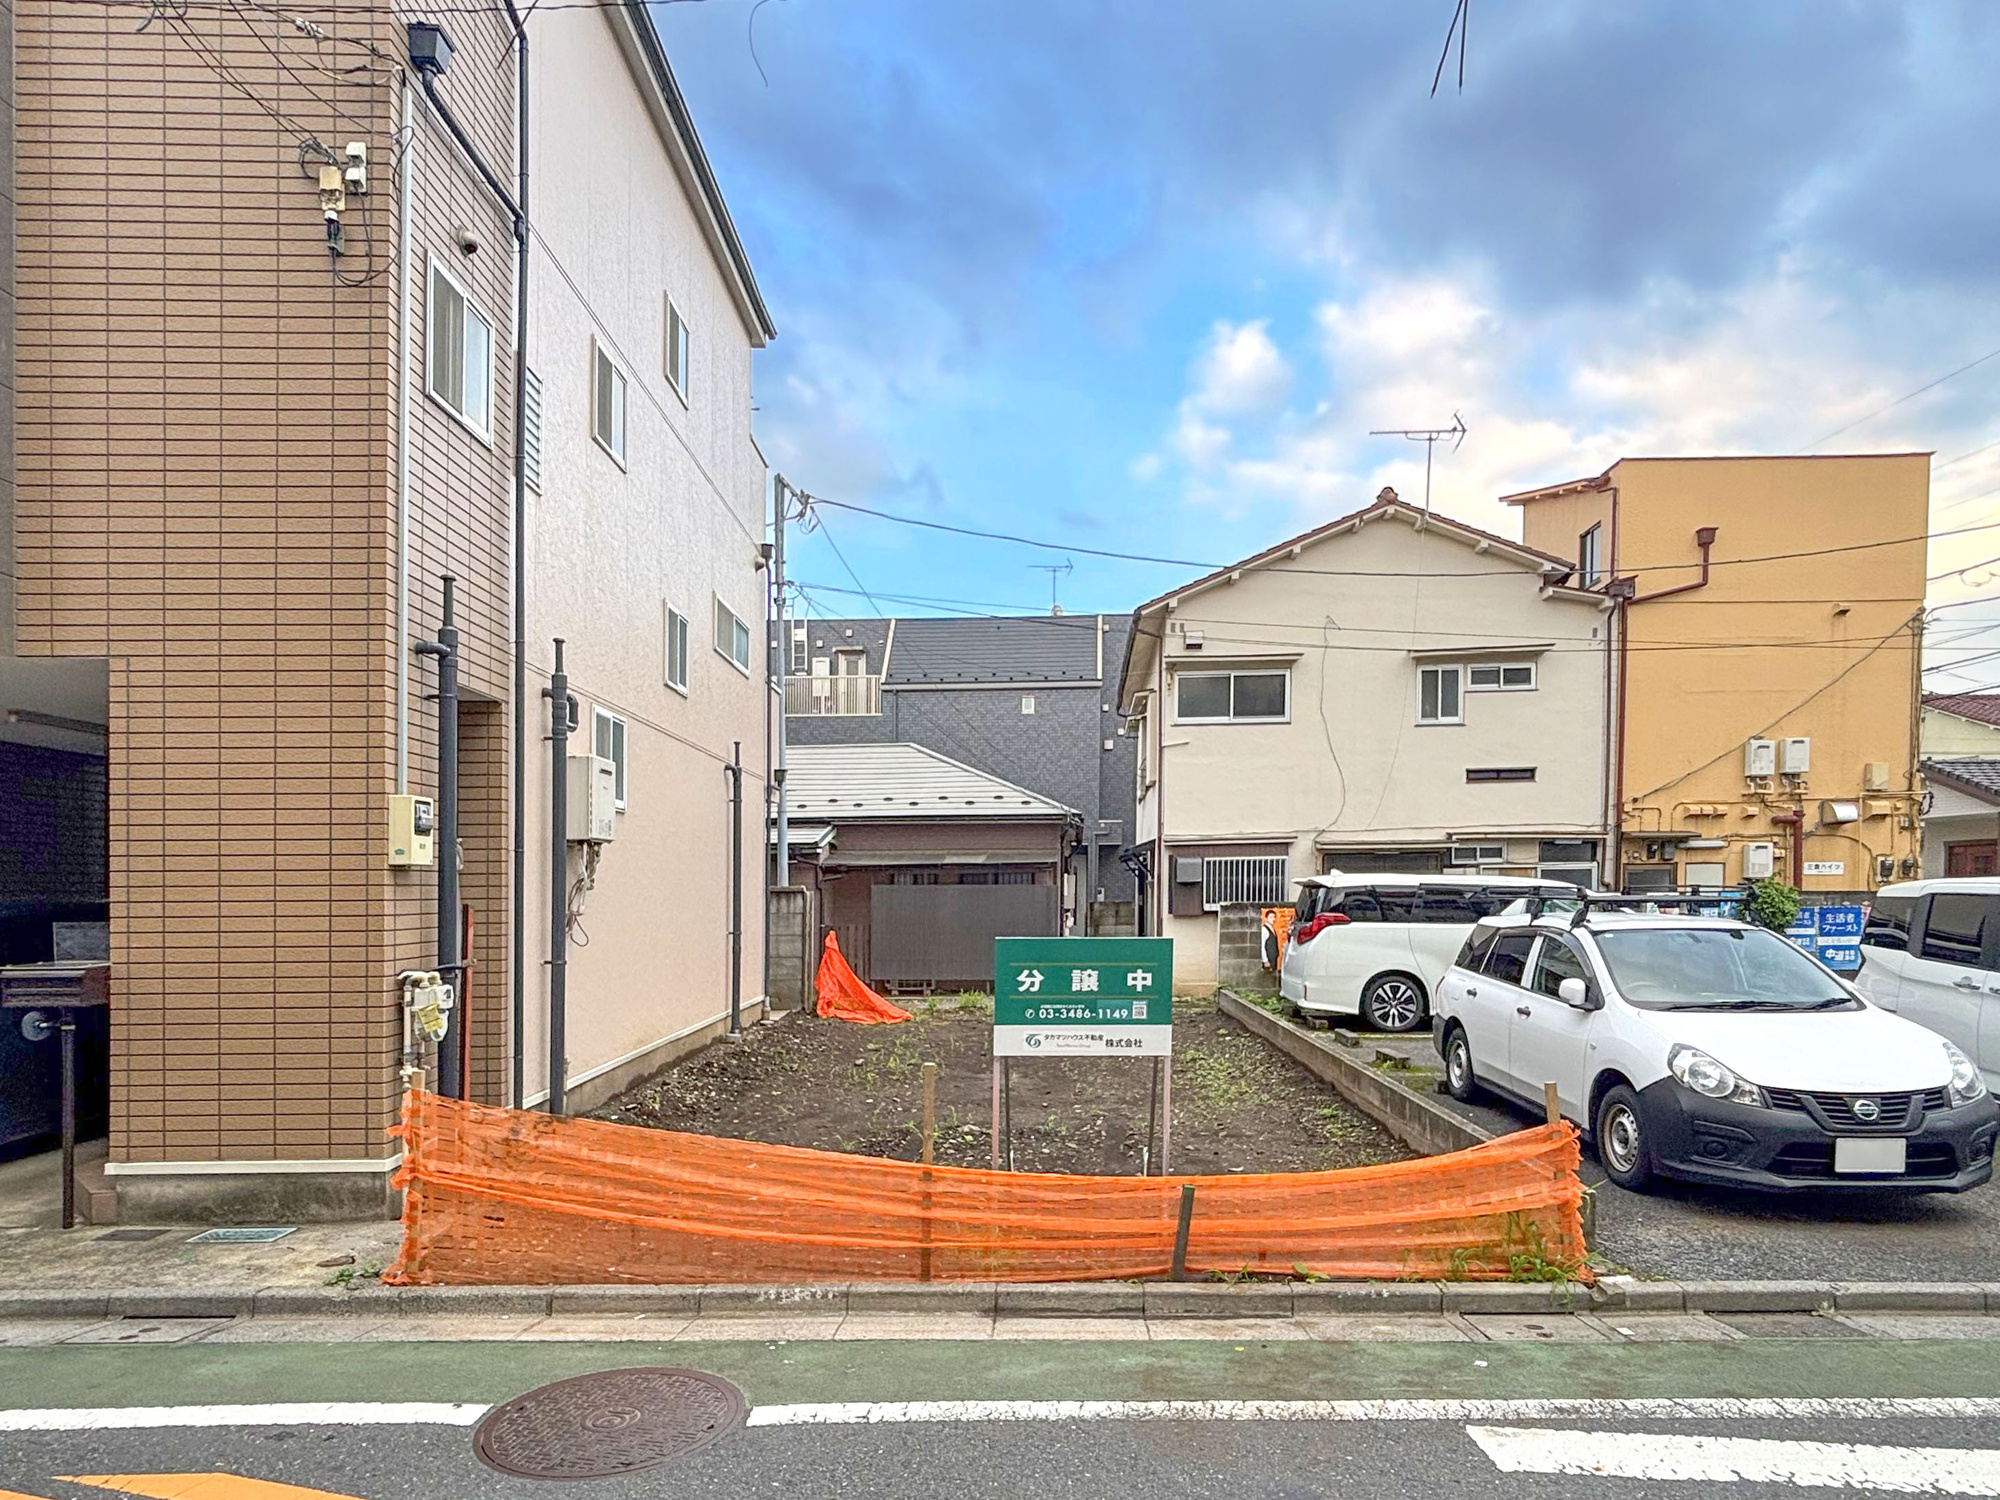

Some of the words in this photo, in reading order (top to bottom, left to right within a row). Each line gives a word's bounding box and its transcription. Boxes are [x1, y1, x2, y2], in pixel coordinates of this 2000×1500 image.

[1825, 913, 1855, 924] 生活者
[1822, 924, 1858, 933] ファースト
[1016, 969, 1152, 992] 分譲中
[1039, 1008, 1128, 1019] 03-3486-1149
[1105, 1038, 1143, 1048] 株式会社
